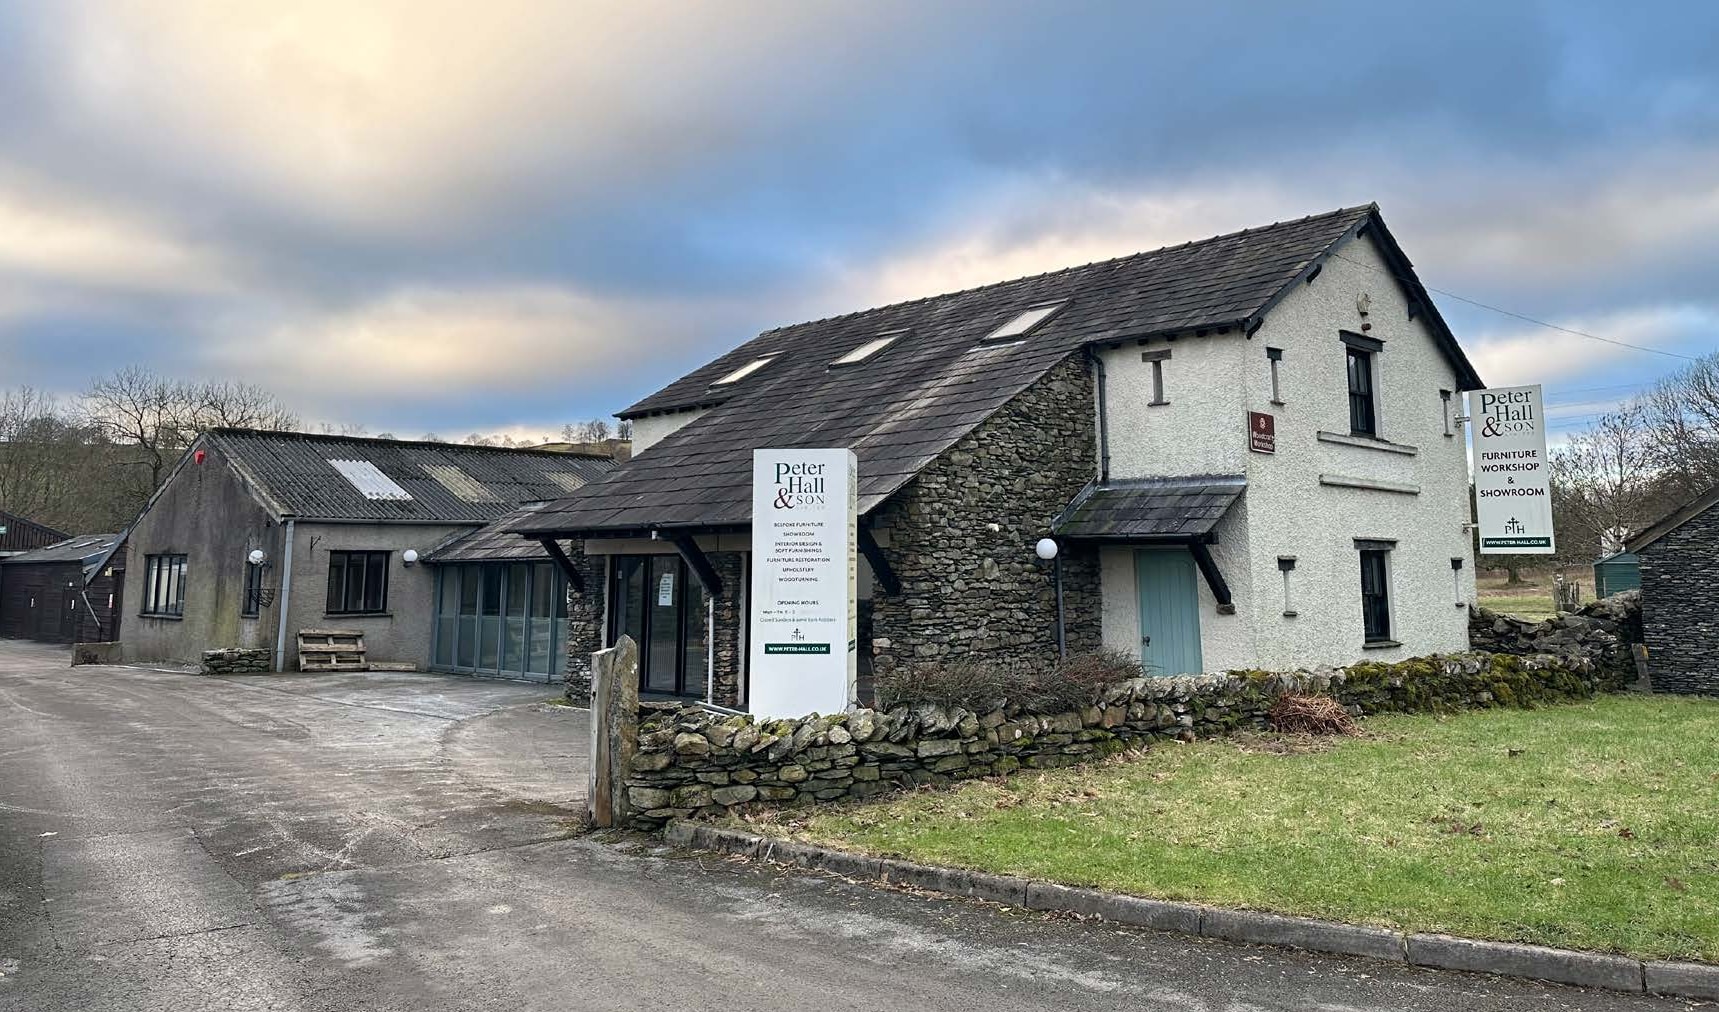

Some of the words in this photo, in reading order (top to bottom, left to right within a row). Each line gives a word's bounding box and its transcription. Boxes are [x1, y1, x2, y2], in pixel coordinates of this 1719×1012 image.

[1480, 391, 1532, 414] Peter
[1495, 405, 1533, 422] Hall
[1482, 416, 1504, 437] &
[1505, 421, 1534, 432] SON
[1481, 450, 1537, 460] FURNITURE
[774, 462, 825, 484] Peter
[1481, 463, 1539, 472] WORKSHOP
[788, 477, 824, 494] Hall
[1507, 476, 1514, 484] &
[774, 488, 796, 510] &
[796, 495, 825, 505] SON
[1480, 488, 1544, 497] SHOWROOM
